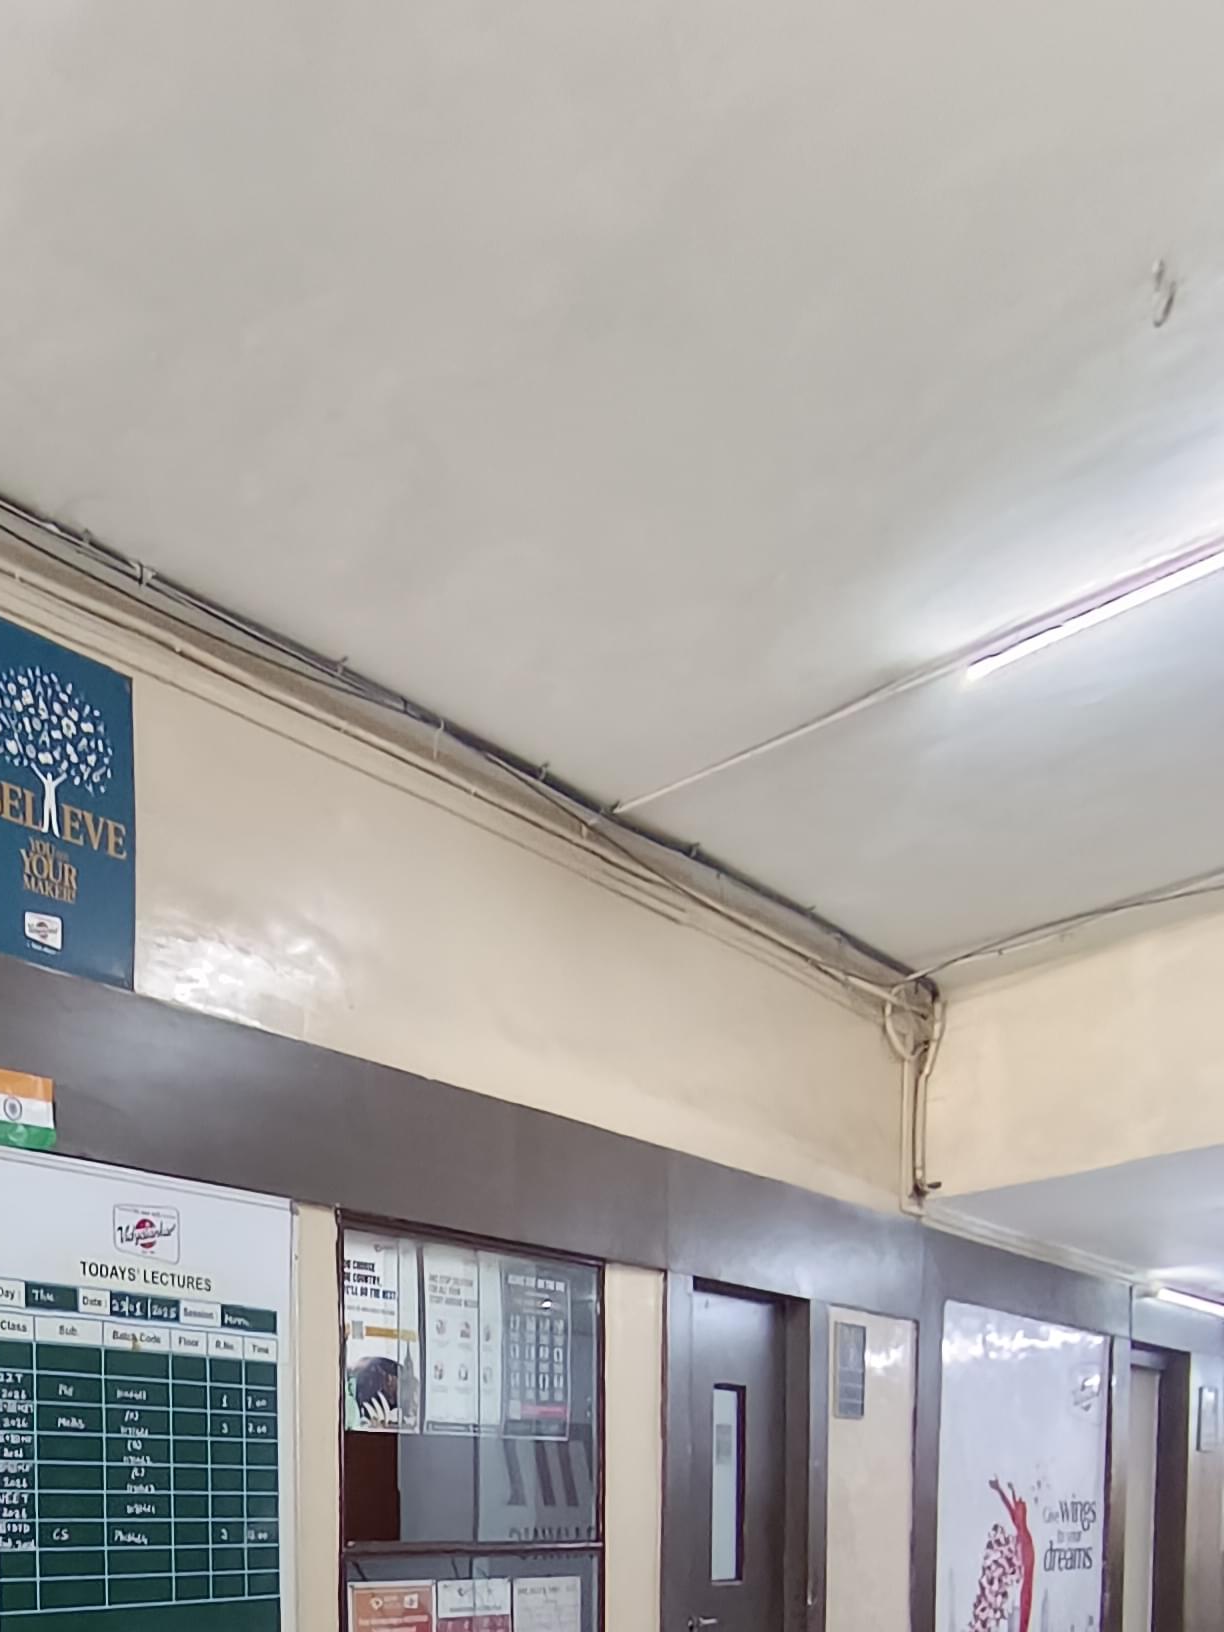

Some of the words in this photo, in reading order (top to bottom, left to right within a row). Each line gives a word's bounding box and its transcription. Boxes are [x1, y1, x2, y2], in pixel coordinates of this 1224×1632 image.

[28, 836, 55, 857] YOU
[19, 848, 78, 890] YOUR
[80, 1261, 140, 1282] TODAYS'
[143, 1269, 212, 1292] LECTURES
[0, 1320, 28, 1334] Class
[140, 1333, 162, 1346] Code
[1059, 1497, 1097, 1532] wings
[1043, 1543, 1093, 1572] dreams
